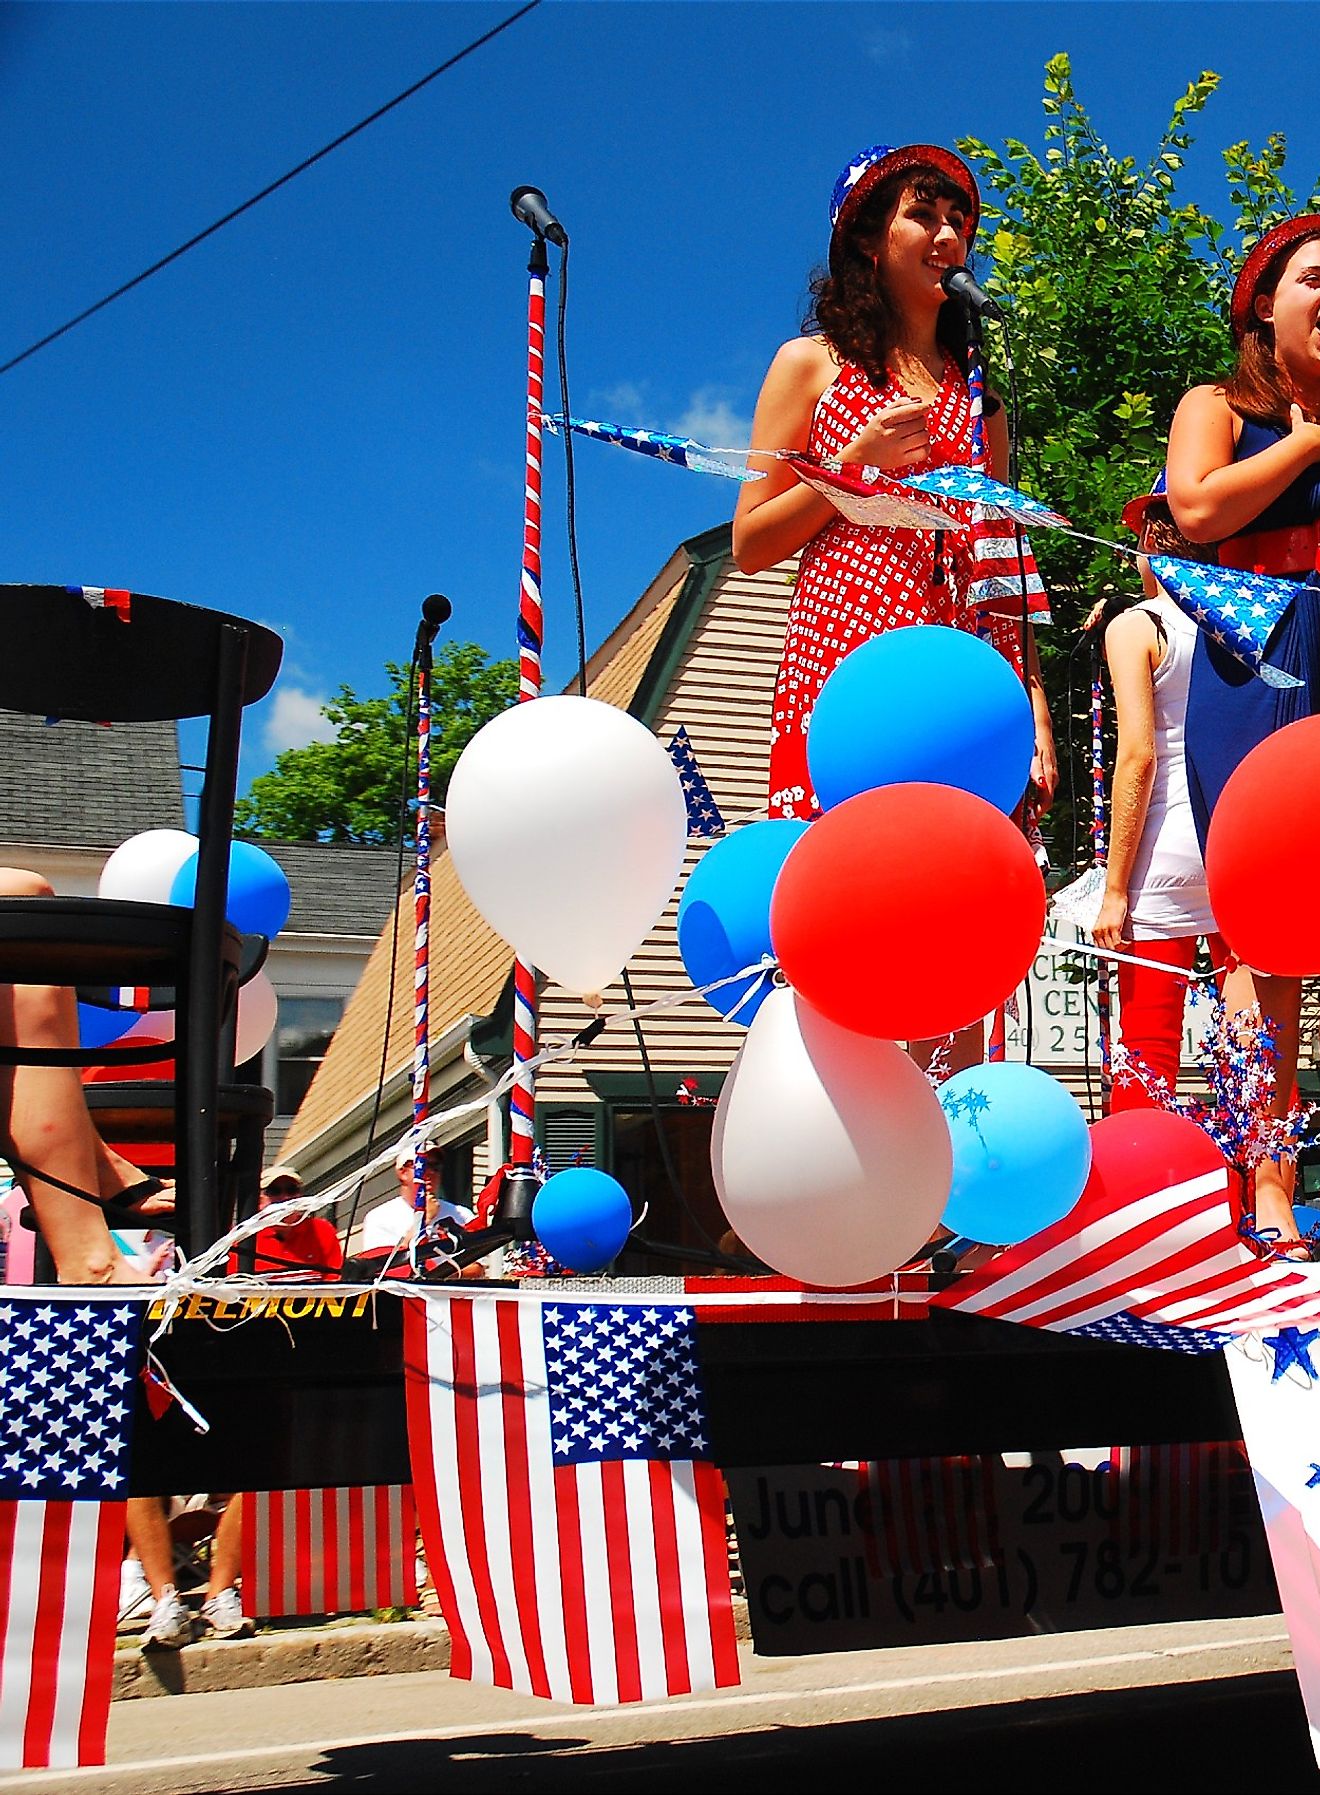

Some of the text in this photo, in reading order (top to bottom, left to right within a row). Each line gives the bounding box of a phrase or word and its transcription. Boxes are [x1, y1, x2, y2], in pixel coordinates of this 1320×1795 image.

[1045, 990, 1119, 1016] CENT
[759, 1556, 870, 1621] call
[1060, 1532, 1275, 1602] 782-10
